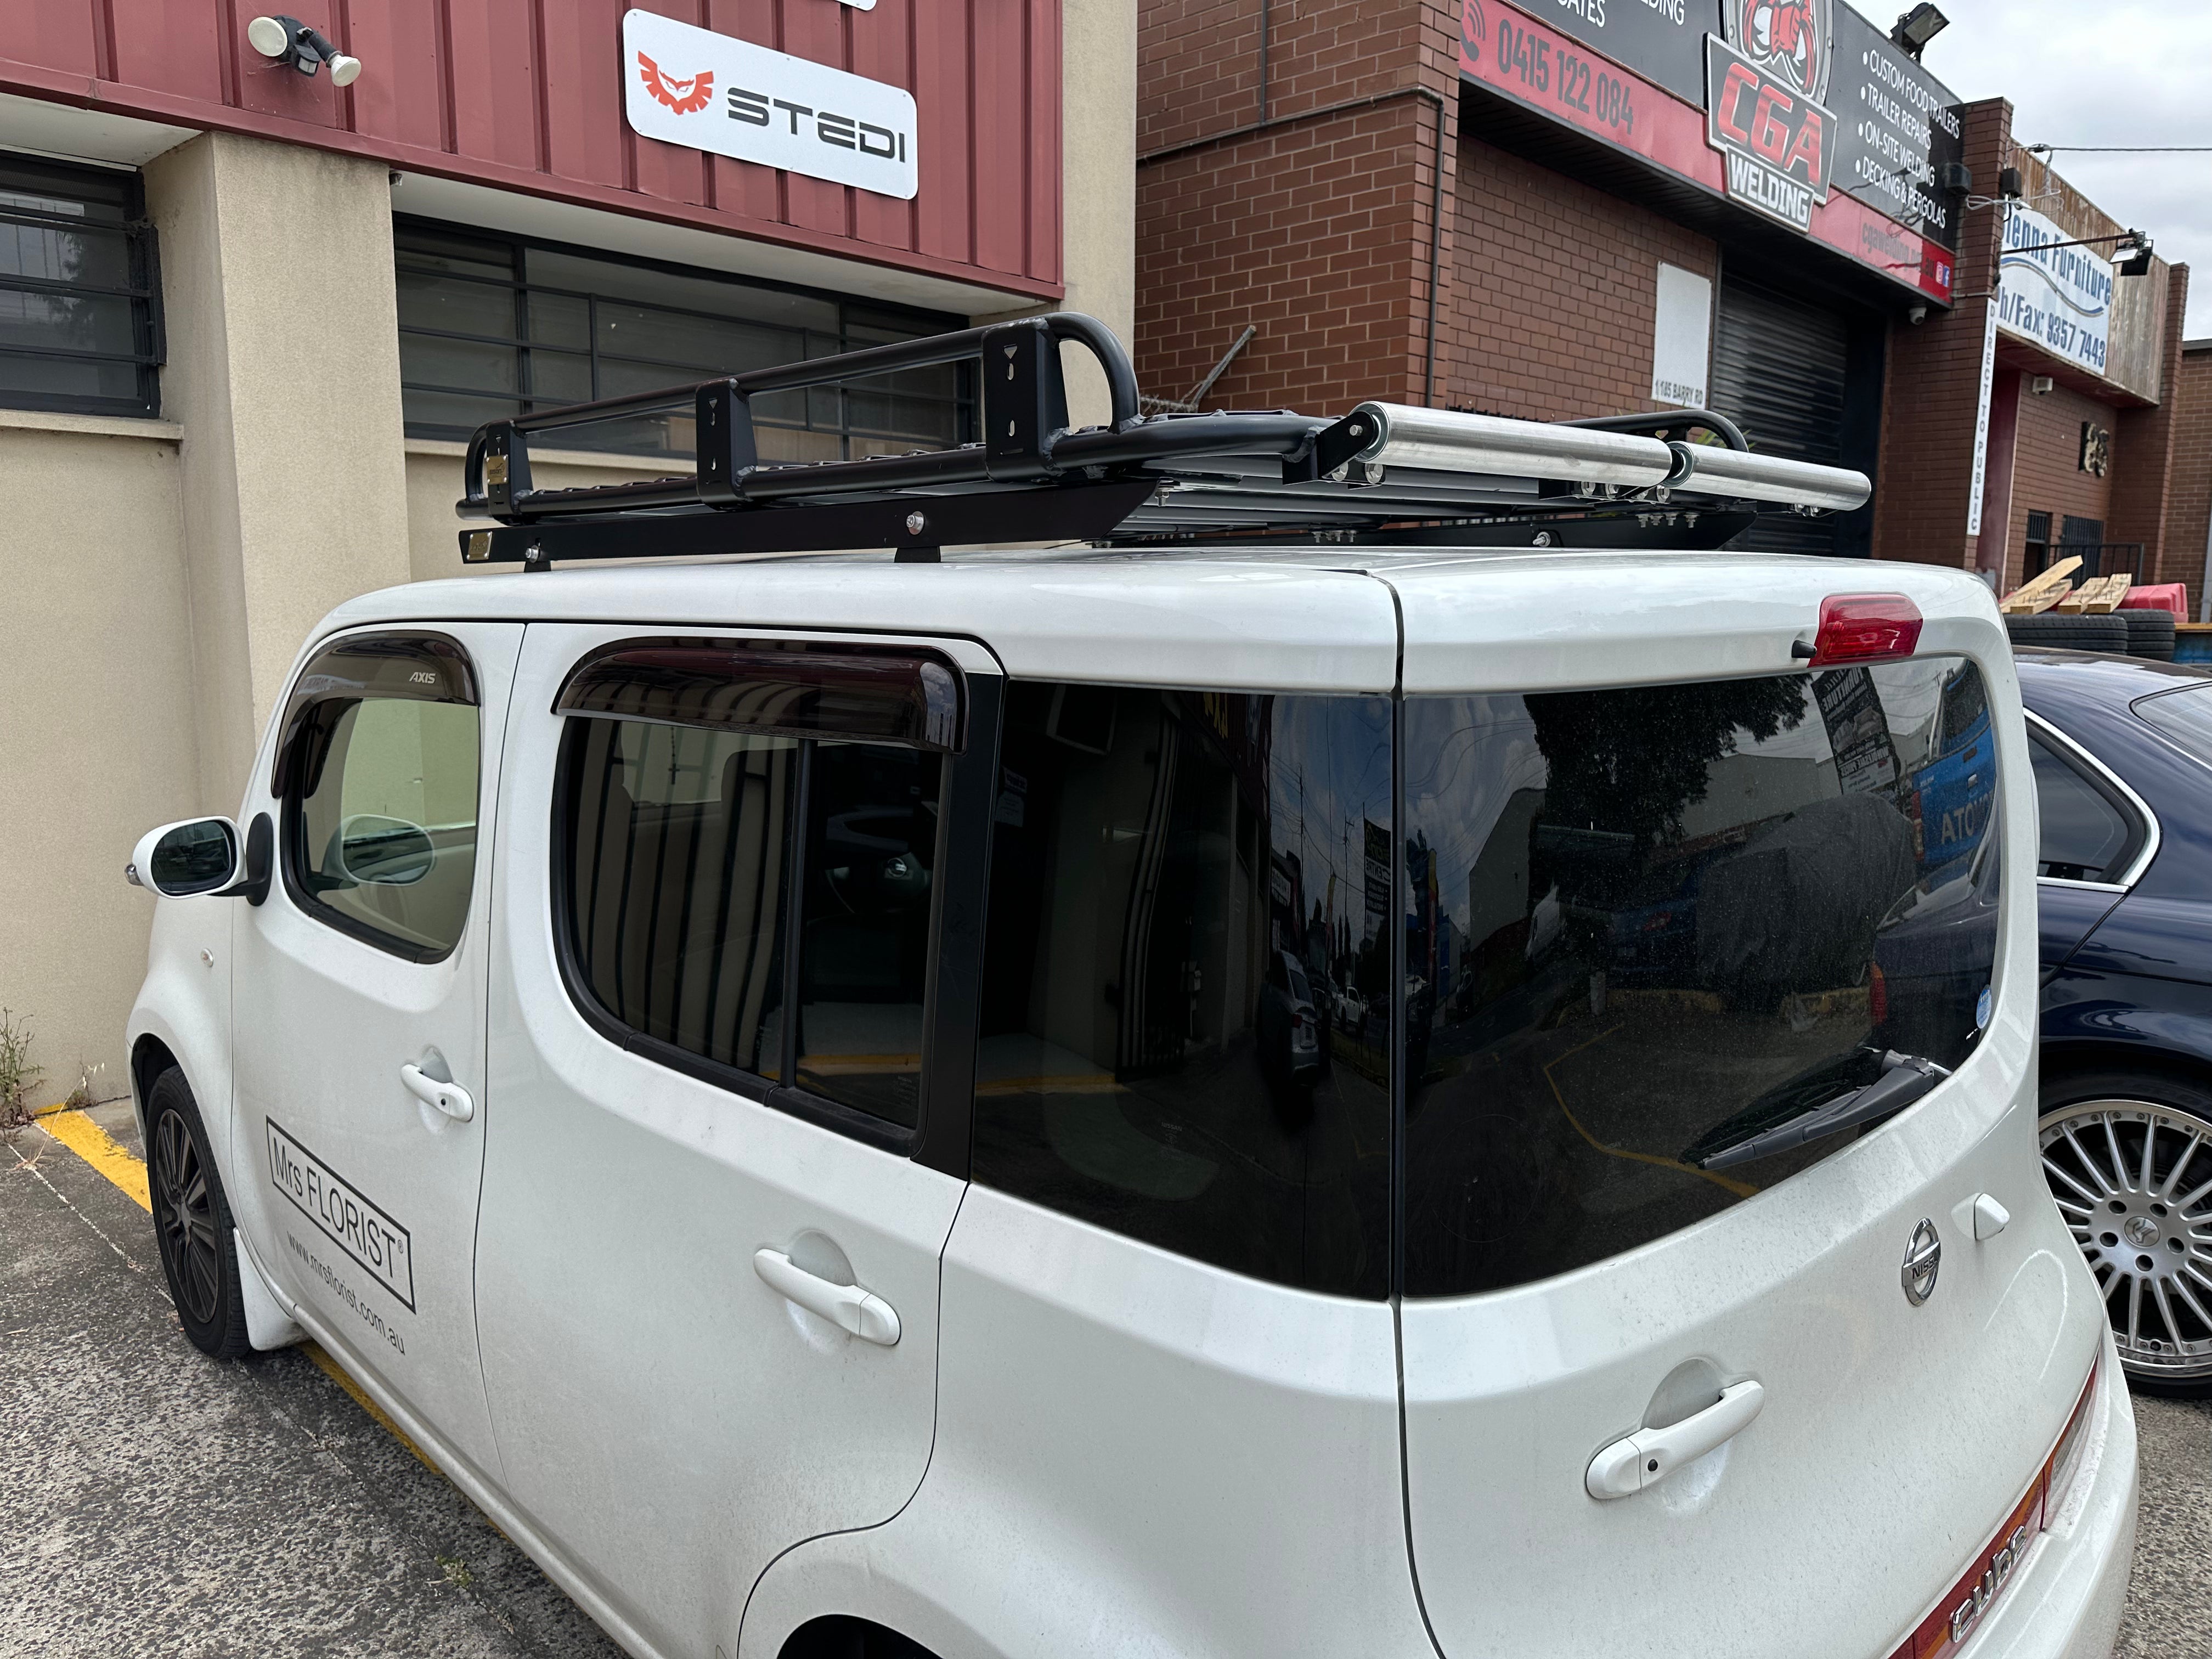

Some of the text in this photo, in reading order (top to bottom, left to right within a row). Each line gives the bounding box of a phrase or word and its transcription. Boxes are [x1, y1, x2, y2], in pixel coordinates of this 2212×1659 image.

[1498, 19, 1634, 135] 0415 122 084
[1867, 83, 1932, 150] TRAILER REPAIRS
[1870, 49, 1960, 139] CUSTOM FOOD TRAILERS
[727, 87, 906, 163] STEDI
[1718, 61, 1822, 186] CGA
[1865, 121, 1935, 187] ON-SITE WELDING
[1730, 154, 1810, 224] WELDING
[1862, 156, 1946, 229] DECKING & PERGOLAS
[2004, 214, 2111, 306] ienna Furniture
[1998, 285, 2106, 368] h/Fax: 9357 7443
[1970, 304, 1995, 531] DIRECT TO PUBLIC
[409, 672, 436, 684] AXIS
[274, 1137, 303, 1197] Mrs
[287, 1231, 406, 1356] www.mrsflorist.com.au
